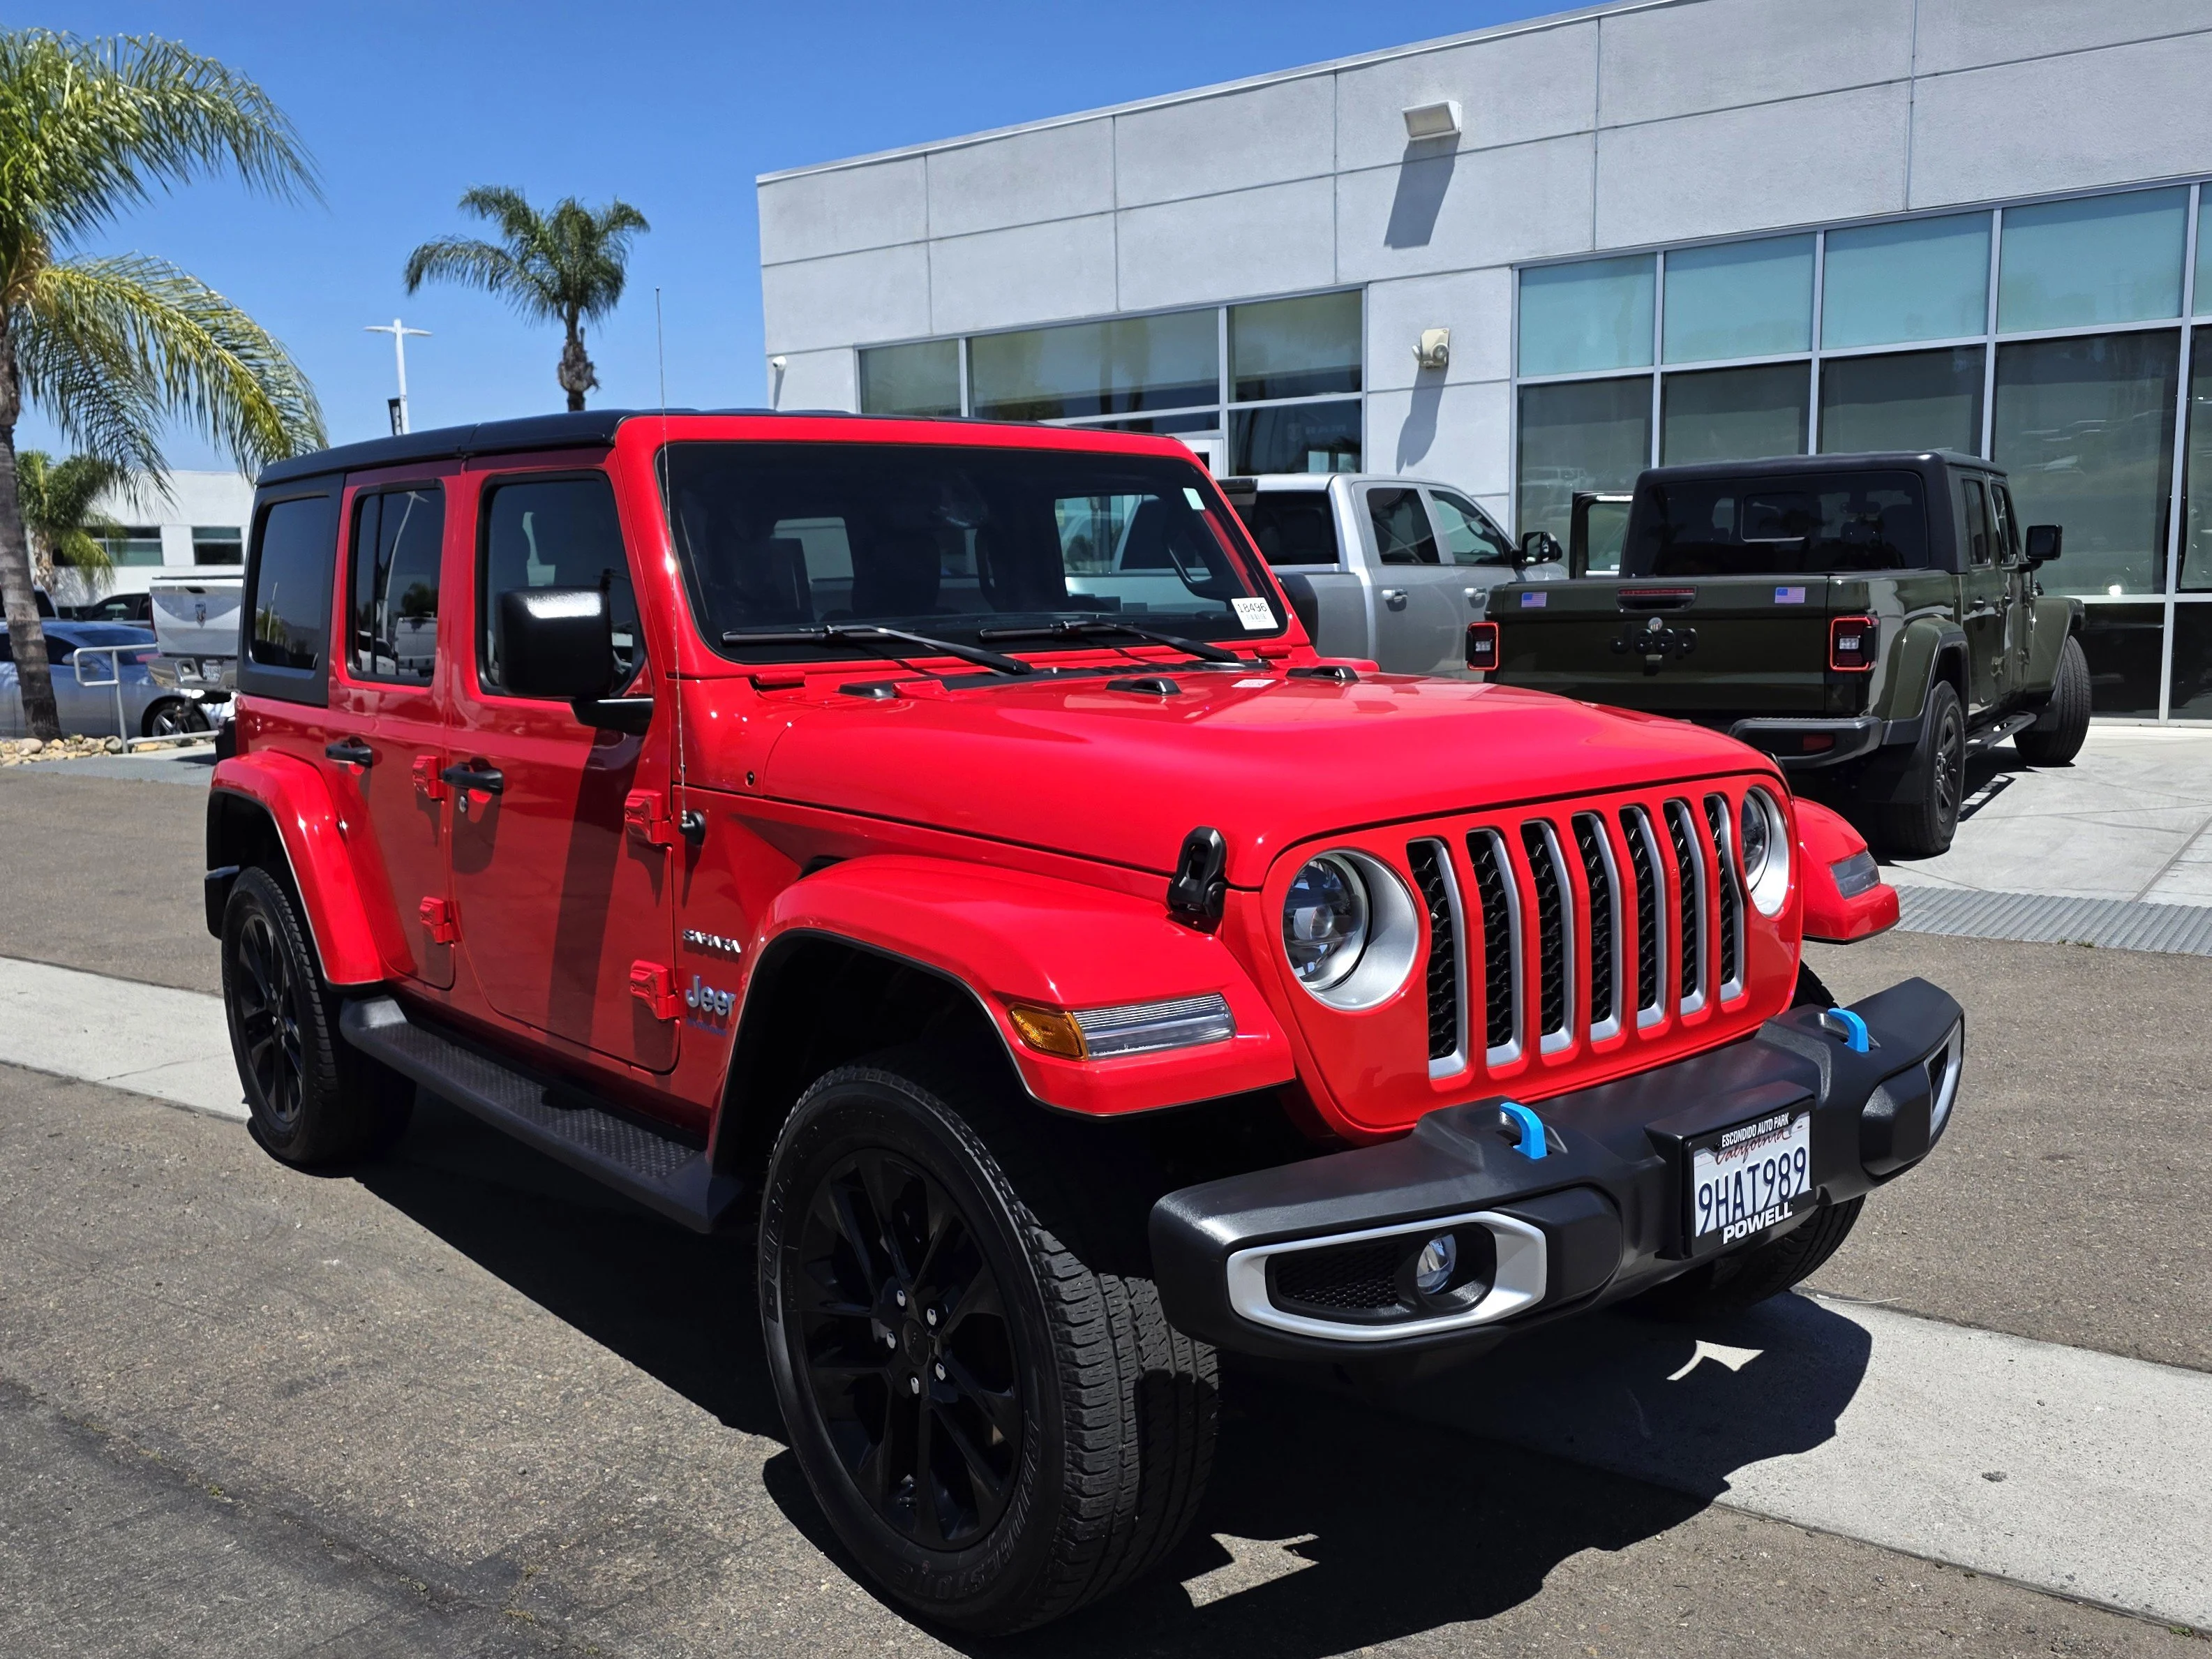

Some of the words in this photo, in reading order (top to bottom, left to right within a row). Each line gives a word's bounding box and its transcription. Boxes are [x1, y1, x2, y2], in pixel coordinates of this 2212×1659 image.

[1237, 602, 1267, 613] 18496
[1610, 622, 1699, 660] Jeep
[1714, 1126, 1792, 1166] California
[1721, 1127, 1757, 1149] ESCONDIDO
[1757, 1118, 1774, 1136] AUTO
[1773, 1112, 1790, 1129] PARK
[1698, 1146, 1807, 1236] 9HAT989
[1722, 1201, 1793, 1245] POWELL
